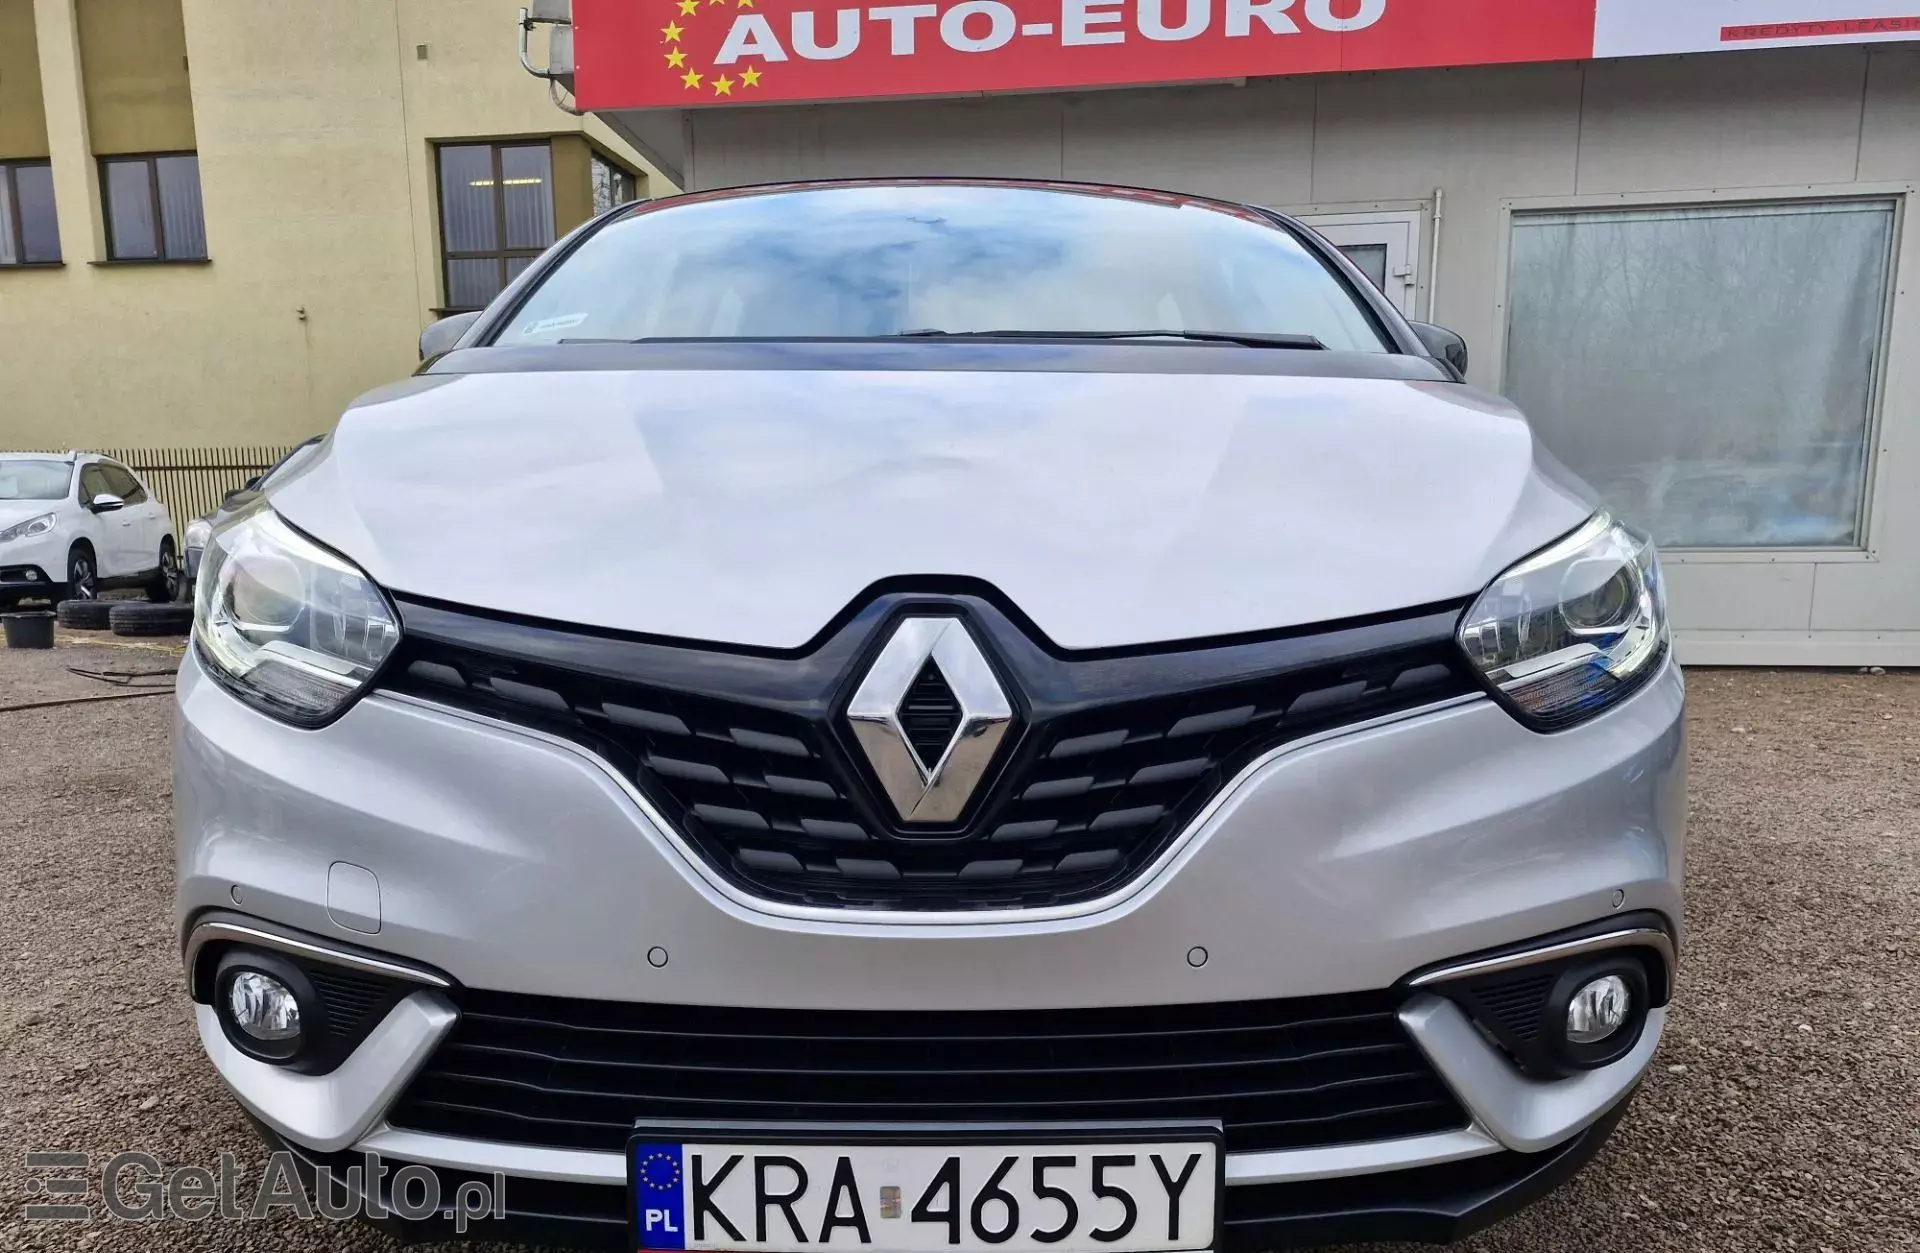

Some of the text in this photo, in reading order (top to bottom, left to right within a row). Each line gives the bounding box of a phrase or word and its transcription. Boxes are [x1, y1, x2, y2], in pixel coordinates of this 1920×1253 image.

[714, 0, 1387, 64] AUTO-EURO
[645, 1208, 678, 1232] PL
[691, 1154, 1202, 1245] KRA 4655Y
